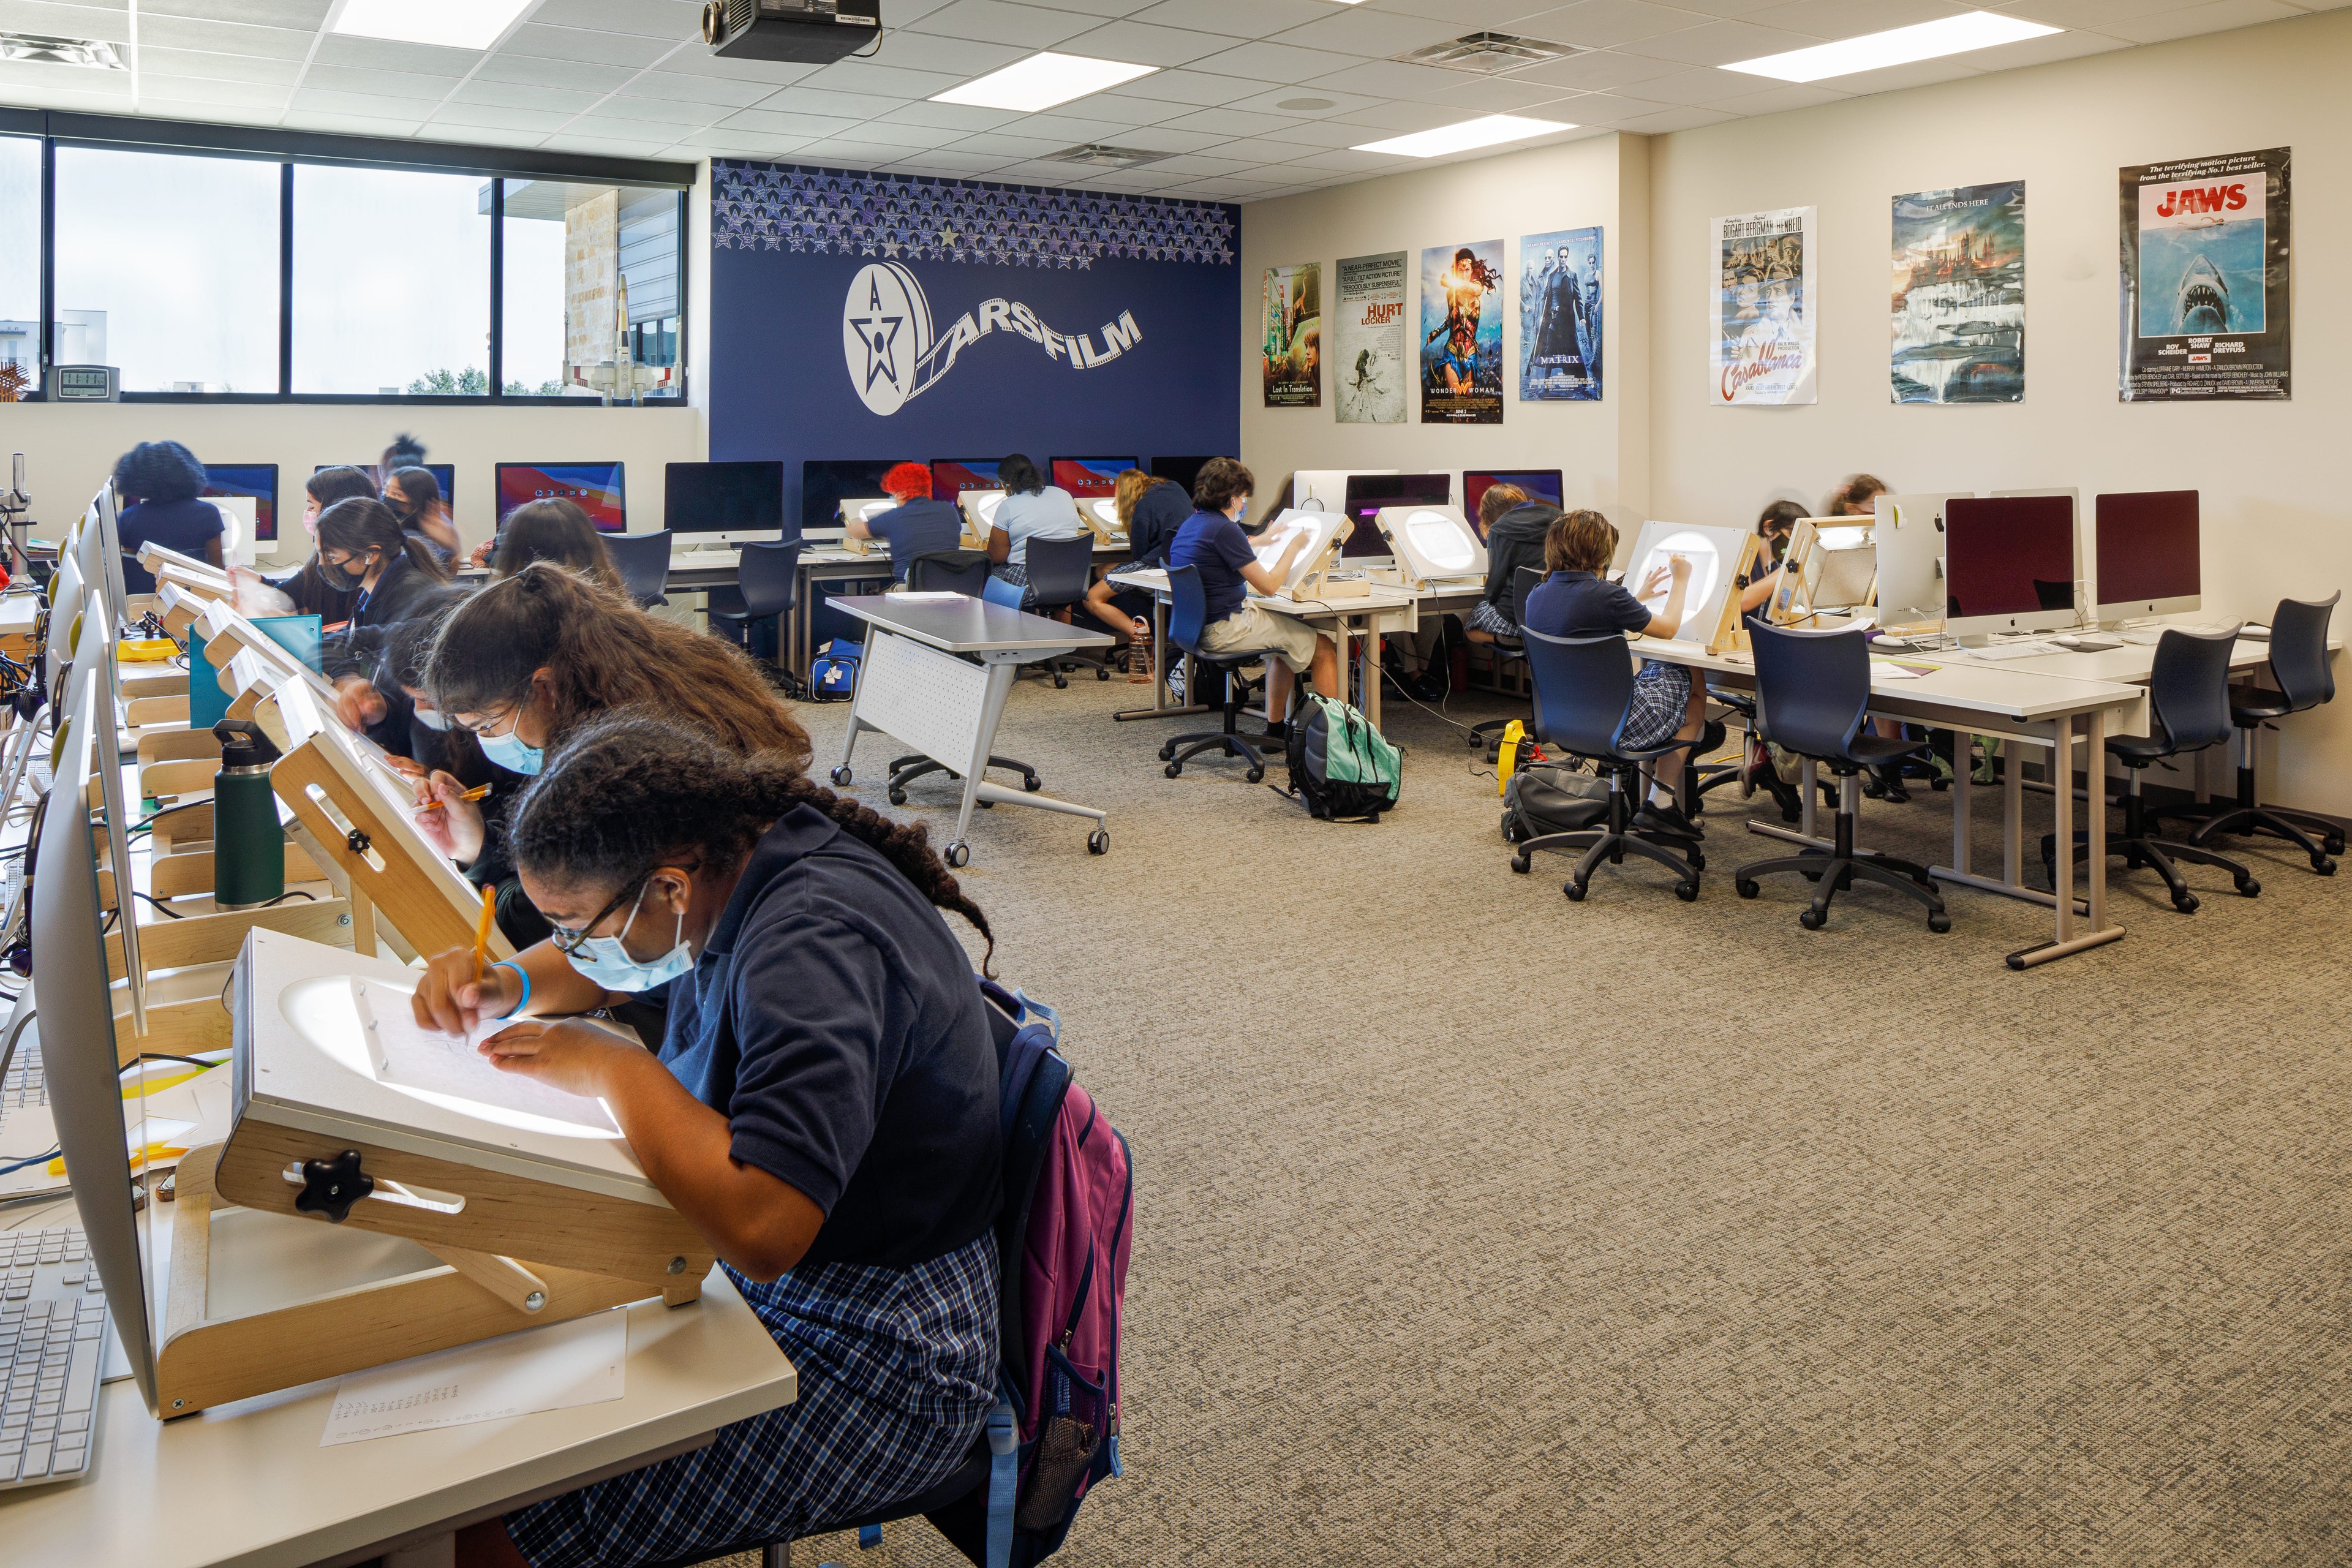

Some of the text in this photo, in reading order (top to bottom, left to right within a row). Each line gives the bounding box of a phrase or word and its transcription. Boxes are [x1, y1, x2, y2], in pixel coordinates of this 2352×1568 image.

[2165, 162, 2199, 172] terrifying
[2200, 159, 2226, 168] motion
[2228, 156, 2256, 165] picture
[2171, 168, 2206, 178] terrifying
[2243, 162, 2266, 170] seller.
[1948, 201, 1967, 209] ENDS
[1969, 198, 1989, 207] HERE
[2157, 183, 2247, 217] JAWS
[1724, 216, 1802, 239] BOGART BERGMAN HENREID
[1348, 261, 1382, 271] NEAR-PERFECT
[1367, 303, 1403, 318] HURT
[1361, 316, 1390, 325] LOCKER
[1540, 355, 1579, 365] MATRIX
[69, 374, 97, 383] 11:11
[1289, 384, 1313, 393] Translation
